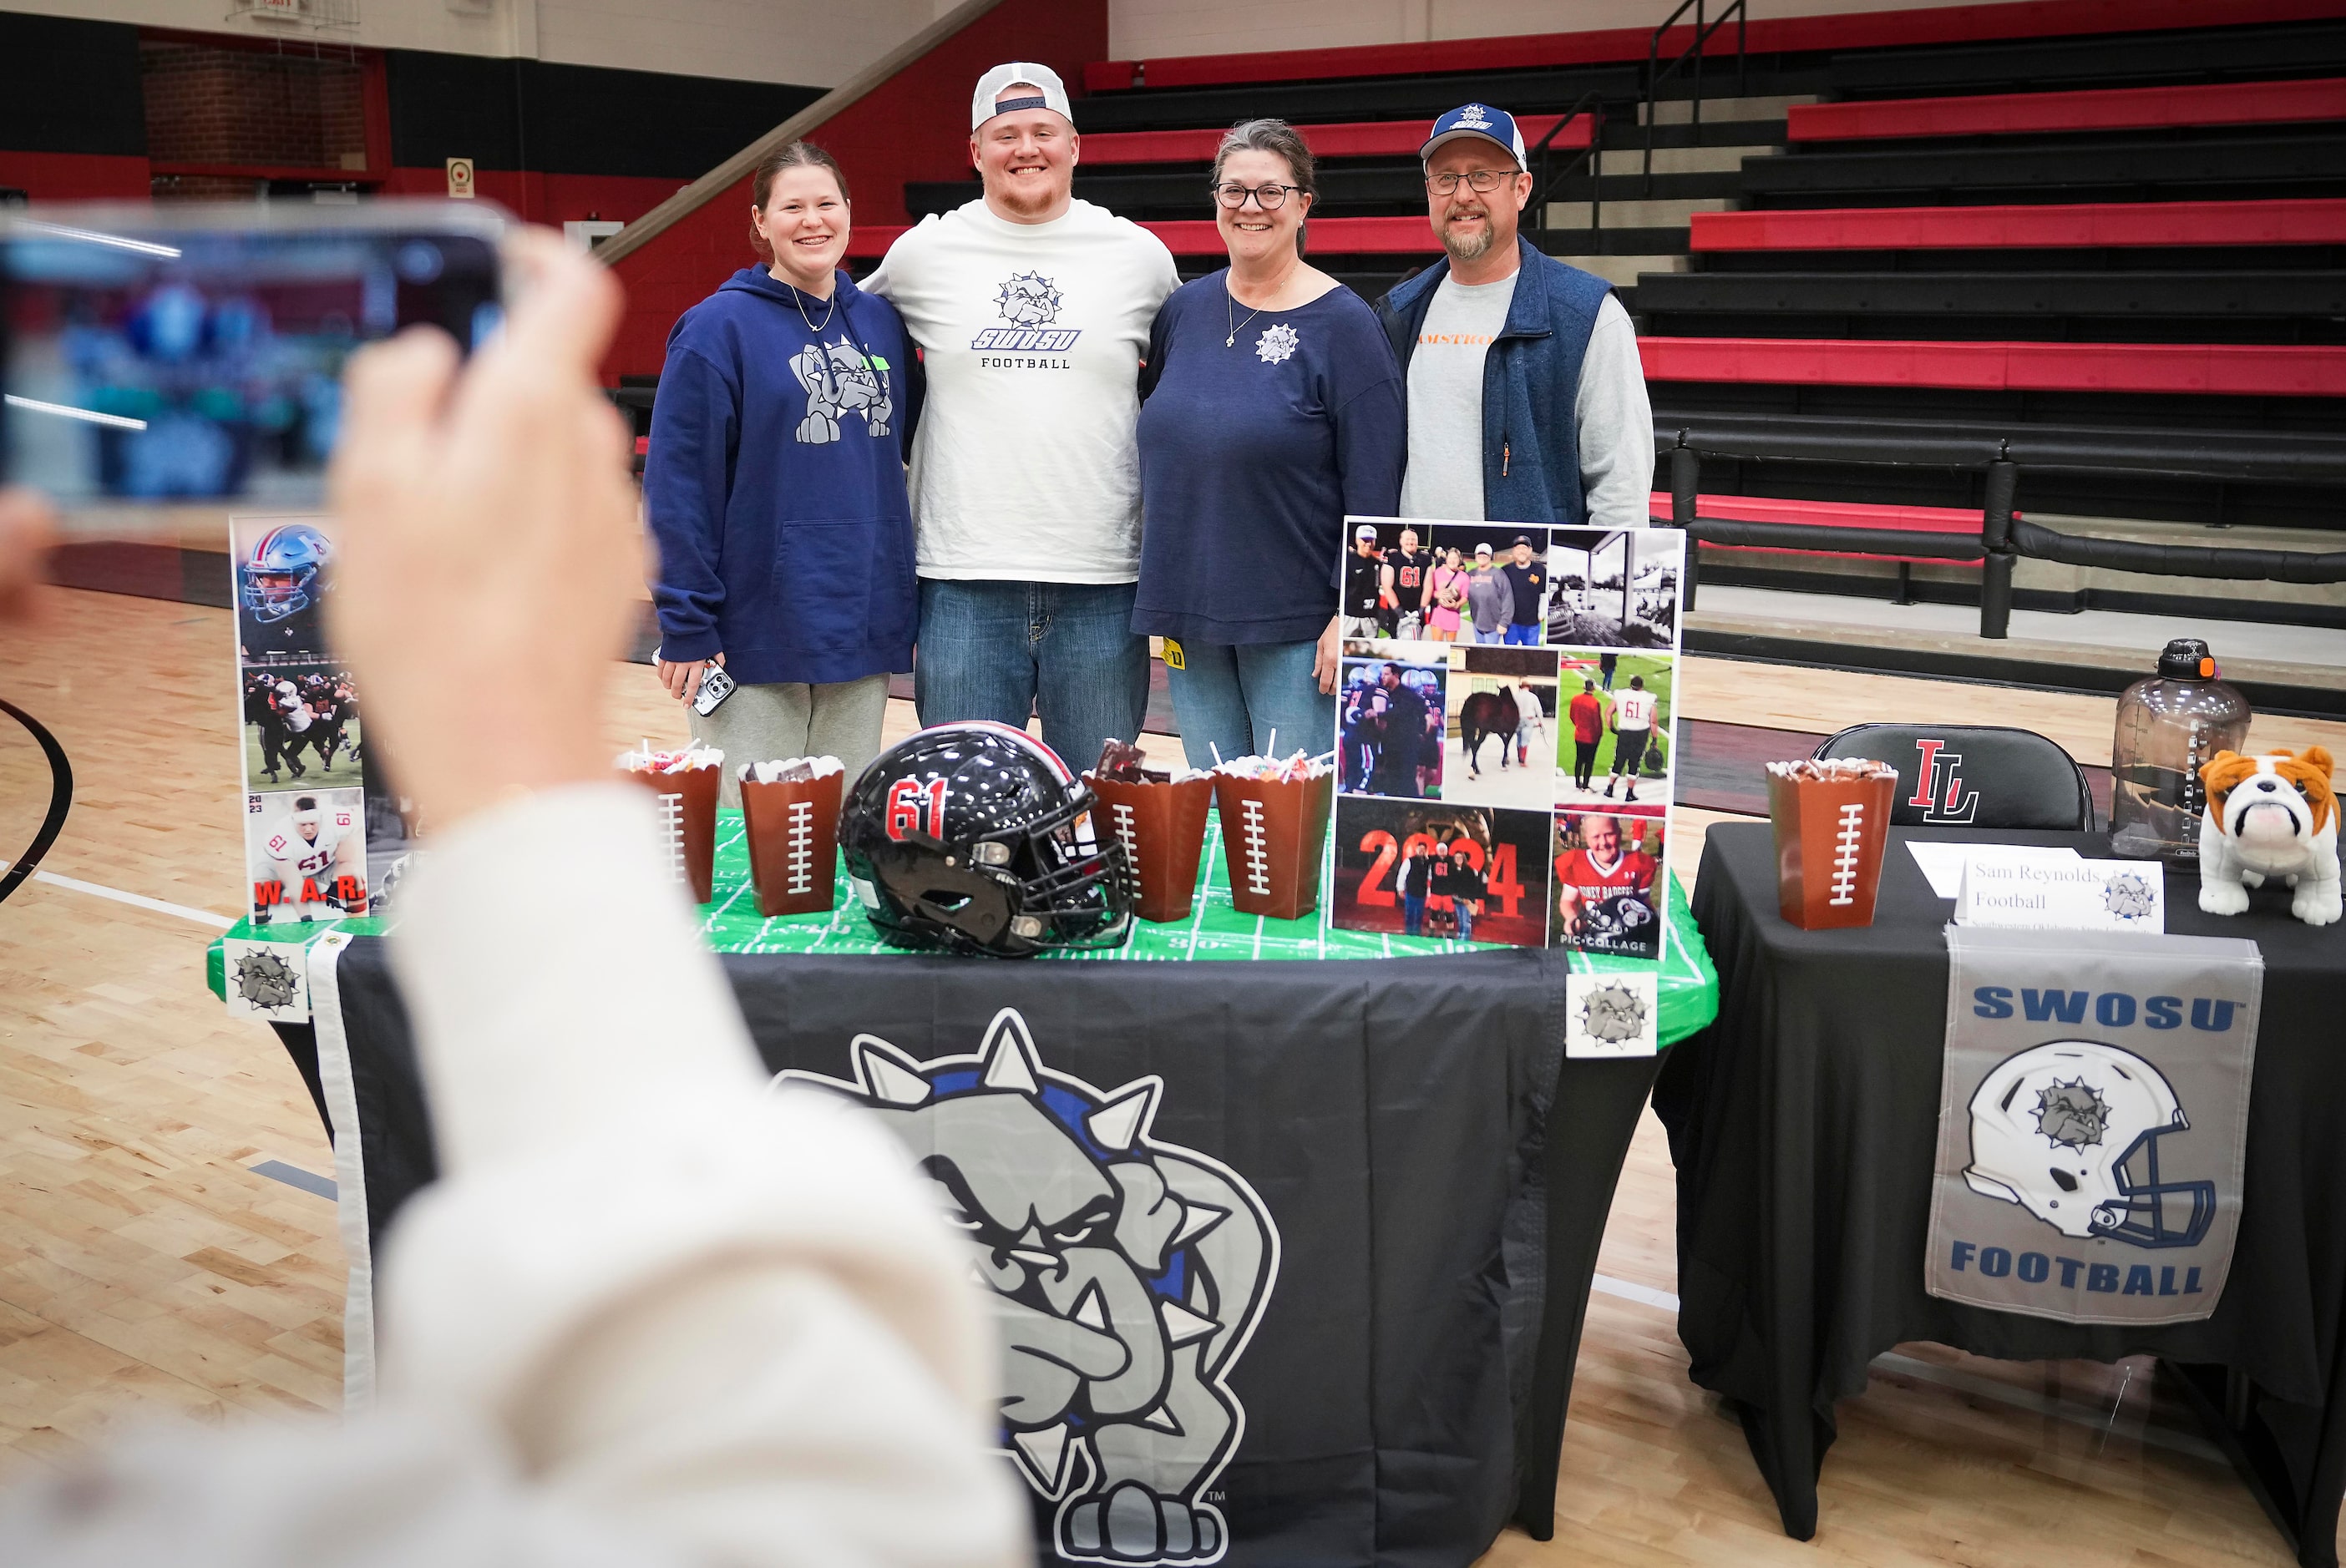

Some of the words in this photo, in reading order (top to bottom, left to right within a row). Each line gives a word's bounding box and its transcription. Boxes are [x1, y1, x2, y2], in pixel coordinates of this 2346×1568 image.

[971, 328, 1082, 351] SWOSU
[981, 357, 1070, 369] FOOTBALL
[1401, 566, 1421, 588] 61
[1624, 701, 1640, 720] 61
[249, 795, 261, 803] 20
[249, 805, 262, 813] 23
[885, 776, 950, 842] 61
[336, 812, 351, 826] 61
[269, 835, 287, 852] 61
[1975, 862, 2013, 878] Sam
[2019, 863, 2100, 884] Reynolds
[254, 880, 291, 906] W.
[300, 877, 328, 903] A.
[337, 875, 367, 899] R.
[1975, 891, 2046, 909] Football
[1974, 985, 2236, 1033] SWOSU
[1950, 1239, 2203, 1297] FOOTBALL
[1208, 1490, 1226, 1501] TM
